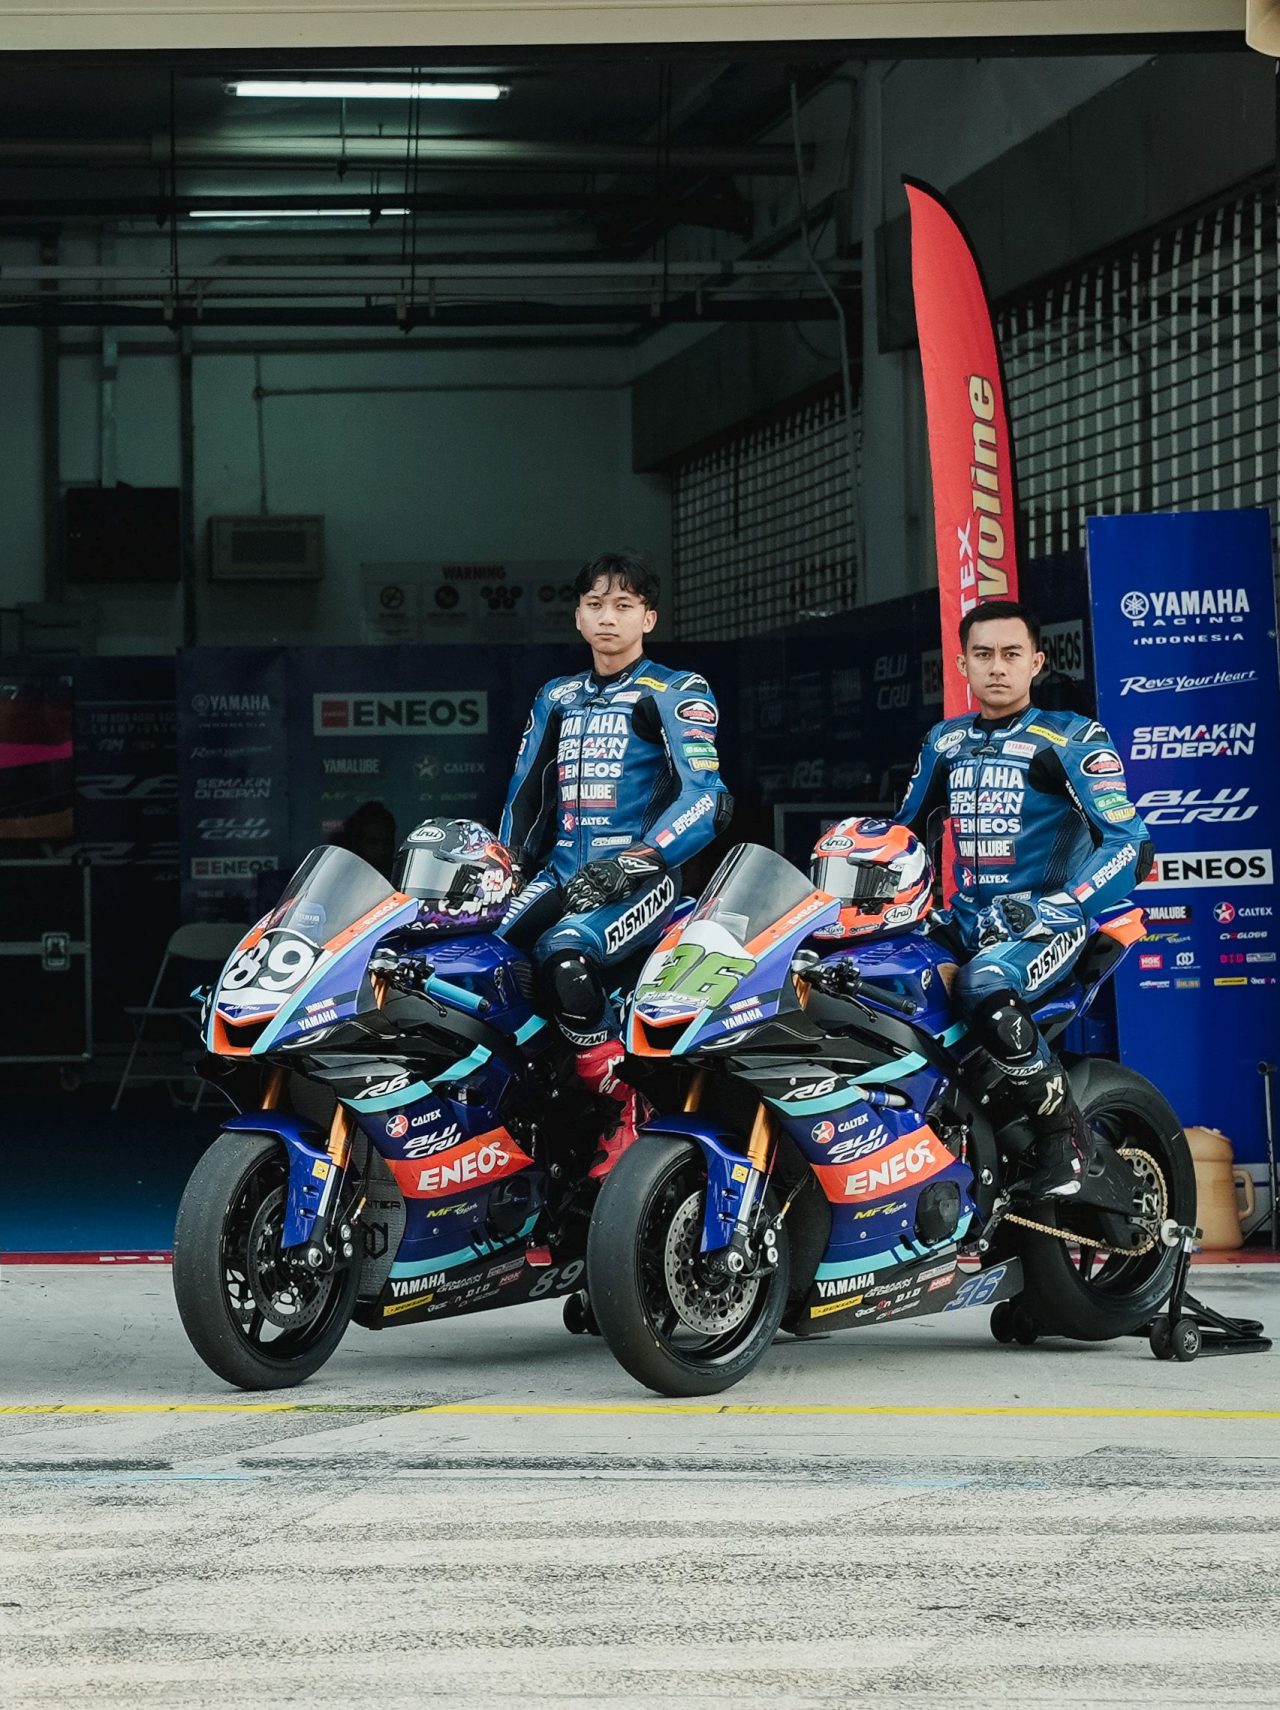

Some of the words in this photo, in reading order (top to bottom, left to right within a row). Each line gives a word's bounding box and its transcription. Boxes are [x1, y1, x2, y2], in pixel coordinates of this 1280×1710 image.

[969, 375, 1009, 602] voline
[442, 565, 506, 580] WARNING
[957, 518, 977, 618] TEX
[1150, 589, 1250, 616] YAMAHA
[1133, 615, 1244, 627] RACING
[1133, 633, 1244, 645] INDONESIA
[874, 654, 908, 681] BLU
[1120, 676, 1176, 696] Revs
[1175, 675, 1214, 692] Your
[1214, 670, 1257, 684] Heart
[210, 694, 271, 710] YAMAHA
[877, 686, 911, 710] CRU
[353, 699, 480, 727] ENEOS
[560, 714, 628, 738] YAMAHA
[1132, 723, 1256, 743] SEMAKIN
[558, 738, 629, 750] SEMAKIN
[566, 749, 626, 760] DEPAN
[1160, 740, 1255, 759] DEPAN
[323, 759, 380, 774] YAMALUBE
[443, 763, 485, 774] CALTEX
[565, 763, 622, 780] ENEOS
[196, 778, 271, 789] SEMAKIN
[949, 766, 1024, 789] YAMAHA
[213, 789, 270, 799] DEPAN
[561, 784, 612, 801] YAMALUBE
[950, 791, 1024, 803] SEMAKIN
[1136, 788, 1250, 807] BLU
[960, 803, 1022, 815] DEPAN
[1144, 806, 1258, 825] CRU
[200, 829, 272, 840] CRU
[960, 818, 1020, 834] ENEOS
[211, 860, 274, 875] ENEOS
[1162, 856, 1266, 881] ENEOS
[363, 901, 400, 926] ENEOS
[789, 900, 826, 925] ENEOS
[1148, 906, 1186, 920] MALUBE
[1238, 907, 1272, 917] CALTEX
[222, 938, 315, 991] 89
[635, 943, 758, 1009] 36
[298, 1009, 338, 1031] YAMAHA
[722, 1008, 763, 1029] YAMAHA
[354, 1071, 410, 1099] R6
[780, 1076, 837, 1100] R6
[411, 1109, 441, 1127] CALTEX
[838, 1113, 870, 1132] CALTEX
[403, 1123, 457, 1150] BLU
[405, 1132, 462, 1159] CRU
[827, 1124, 884, 1155] BLU
[831, 1134, 889, 1163] CRU
[417, 1141, 510, 1191] ENEOS
[844, 1139, 936, 1195] ENEOS
[391, 1273, 446, 1297] YAMAHA
[529, 1260, 585, 1297] 89
[817, 1273, 875, 1298] YAMAHA
[942, 1265, 1008, 1312] 36
[822, 1298, 859, 1313] DUNLOP
